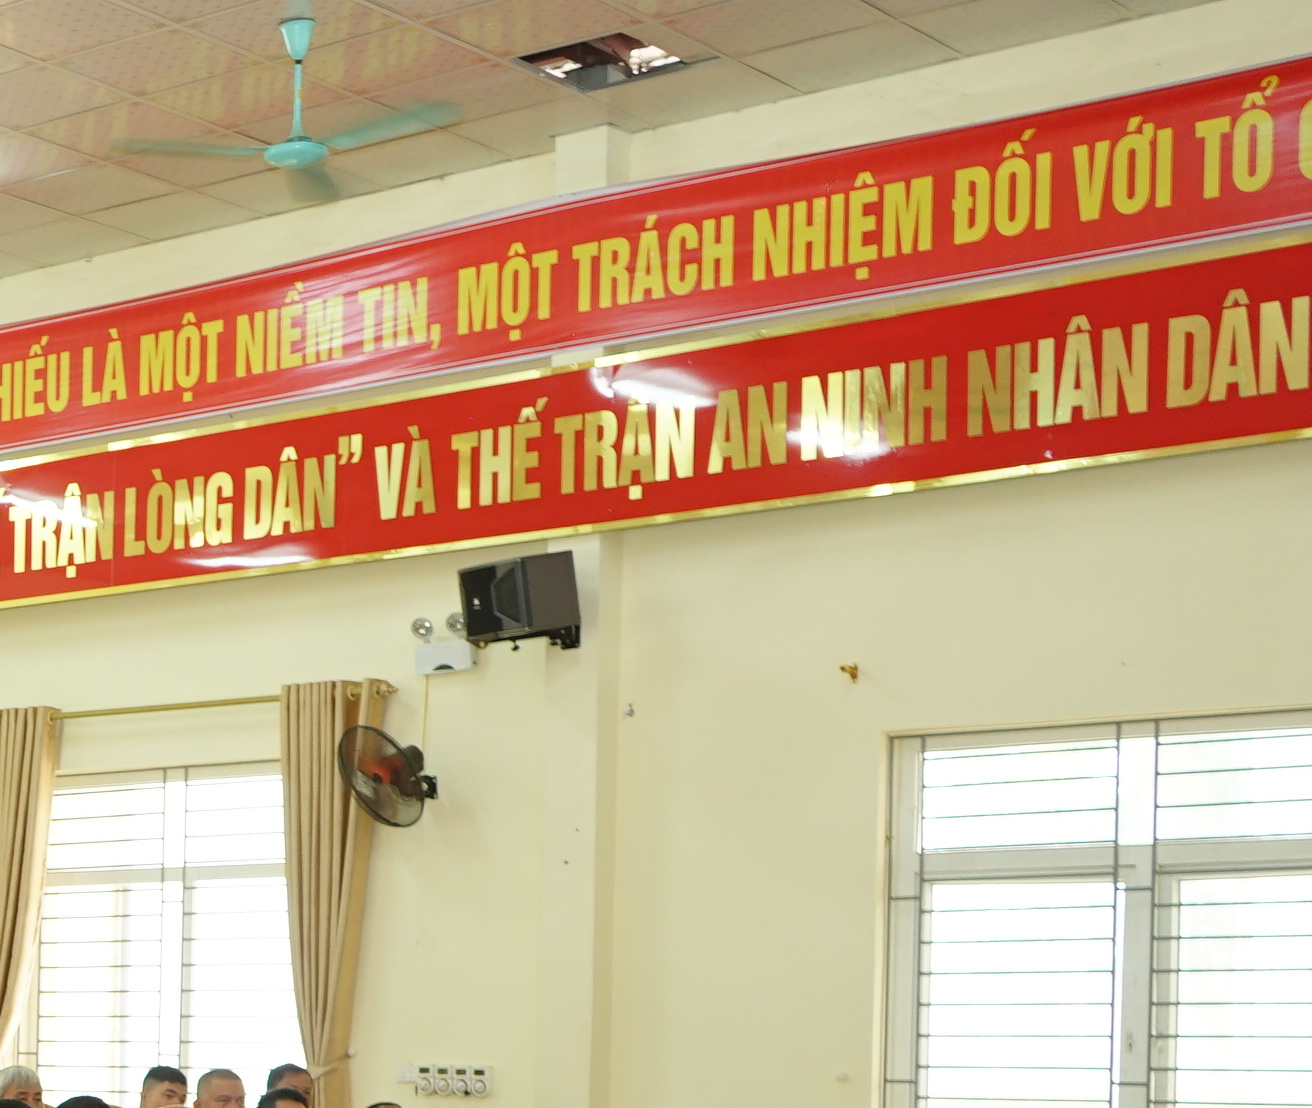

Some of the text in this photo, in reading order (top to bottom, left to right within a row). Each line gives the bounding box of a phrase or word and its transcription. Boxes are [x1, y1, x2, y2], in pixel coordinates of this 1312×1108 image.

[82, 328, 128, 407] LÀ
[139, 311, 224, 402] MỘT
[235, 281, 344, 378] NIỀM
[357, 277, 442, 350] TIN,
[457, 242, 559, 341] MỘT
[572, 214, 735, 313] TRÁCH
[752, 171, 933, 280] NHIỆM
[952, 128, 1052, 246] ĐỐI
[1072, 116, 1174, 223] VỚI
[1194, 74, 1280, 200] TỔ
[8, 482, 115, 578] TRẬN
[123, 468, 234, 557] LÒNG
[374, 425, 436, 520] VÀ
[451, 396, 549, 510] THẾ
[554, 394, 696, 500] TRẬN
[707, 381, 788, 475] AN
[800, 355, 948, 461] NINH
[967, 314, 1149, 438] NHÂN
[1166, 288, 1311, 410] DÂN
